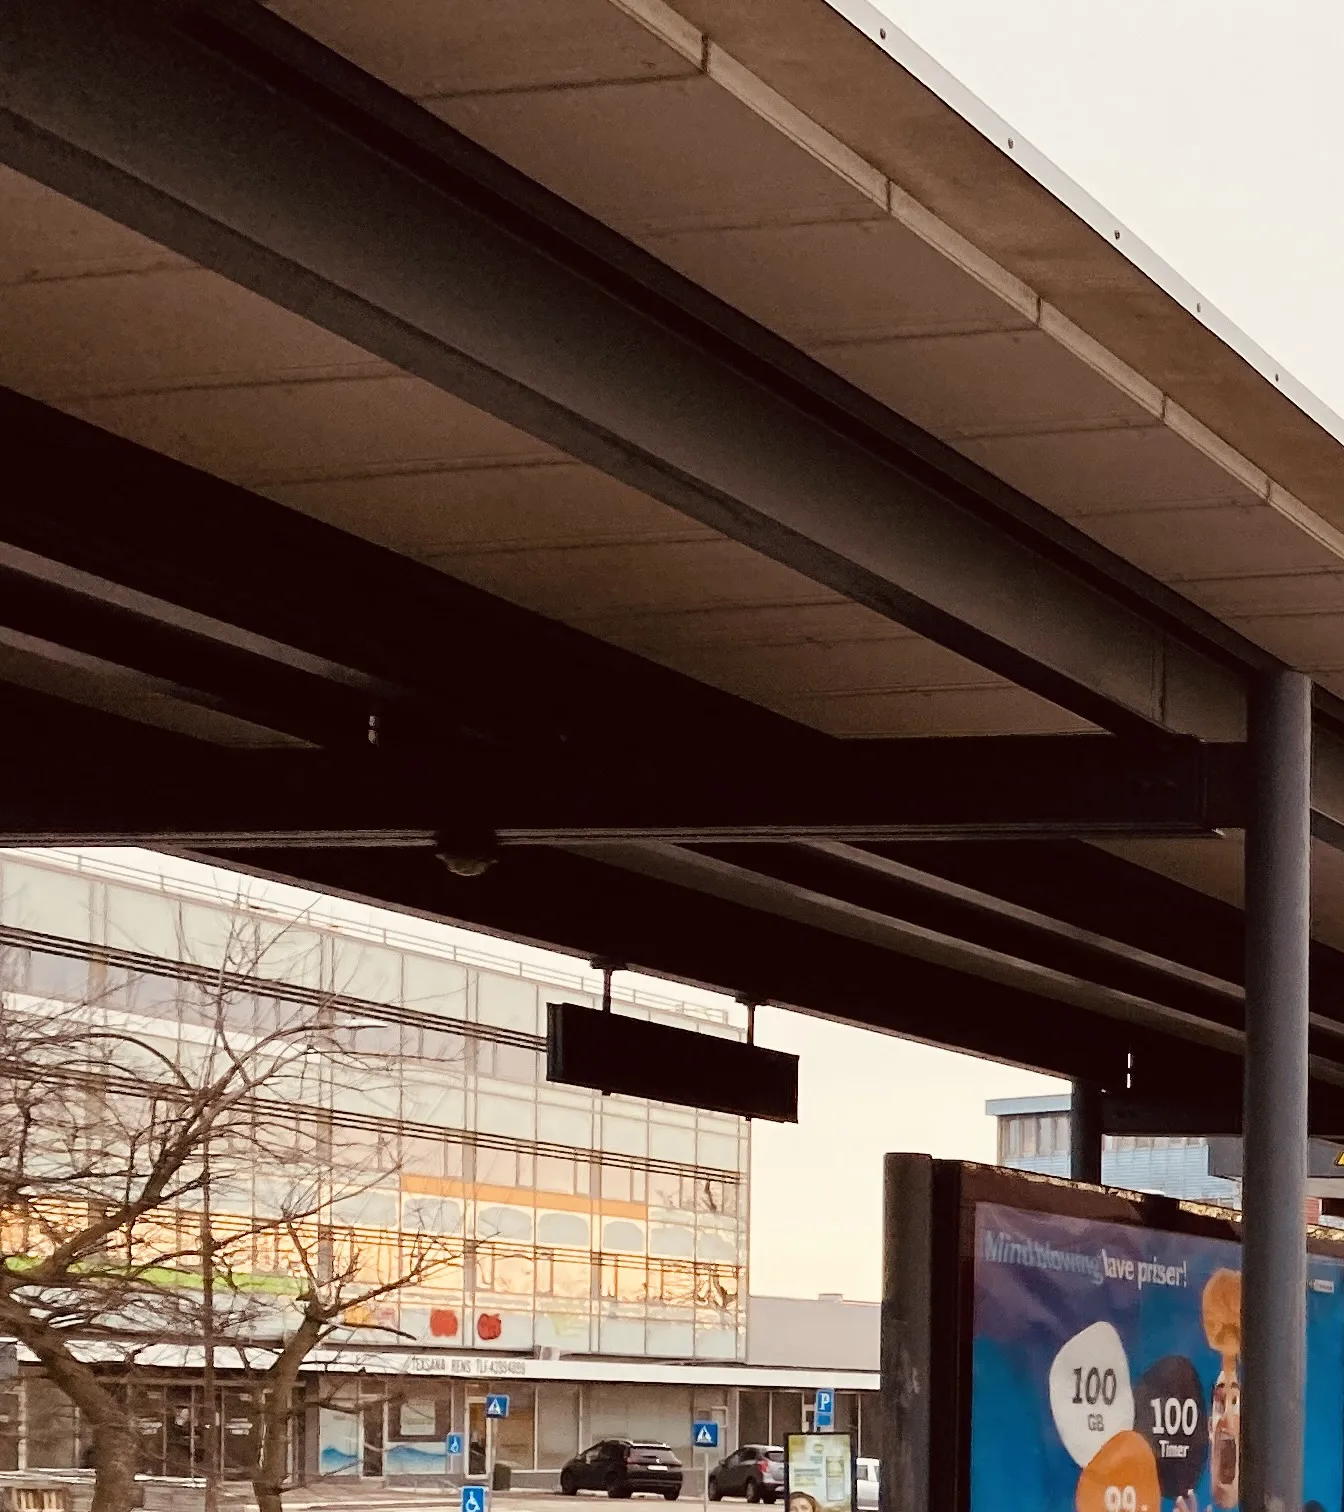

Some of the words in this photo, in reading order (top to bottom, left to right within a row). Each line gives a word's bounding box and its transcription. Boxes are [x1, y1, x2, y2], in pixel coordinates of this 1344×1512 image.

[1101, 1248, 1134, 1280] lave
[1137, 1256, 1187, 1290] priser!
[820, 1392, 831, 1411] P
[1071, 1366, 1118, 1406] 100
[1151, 1397, 1199, 1437] 100
